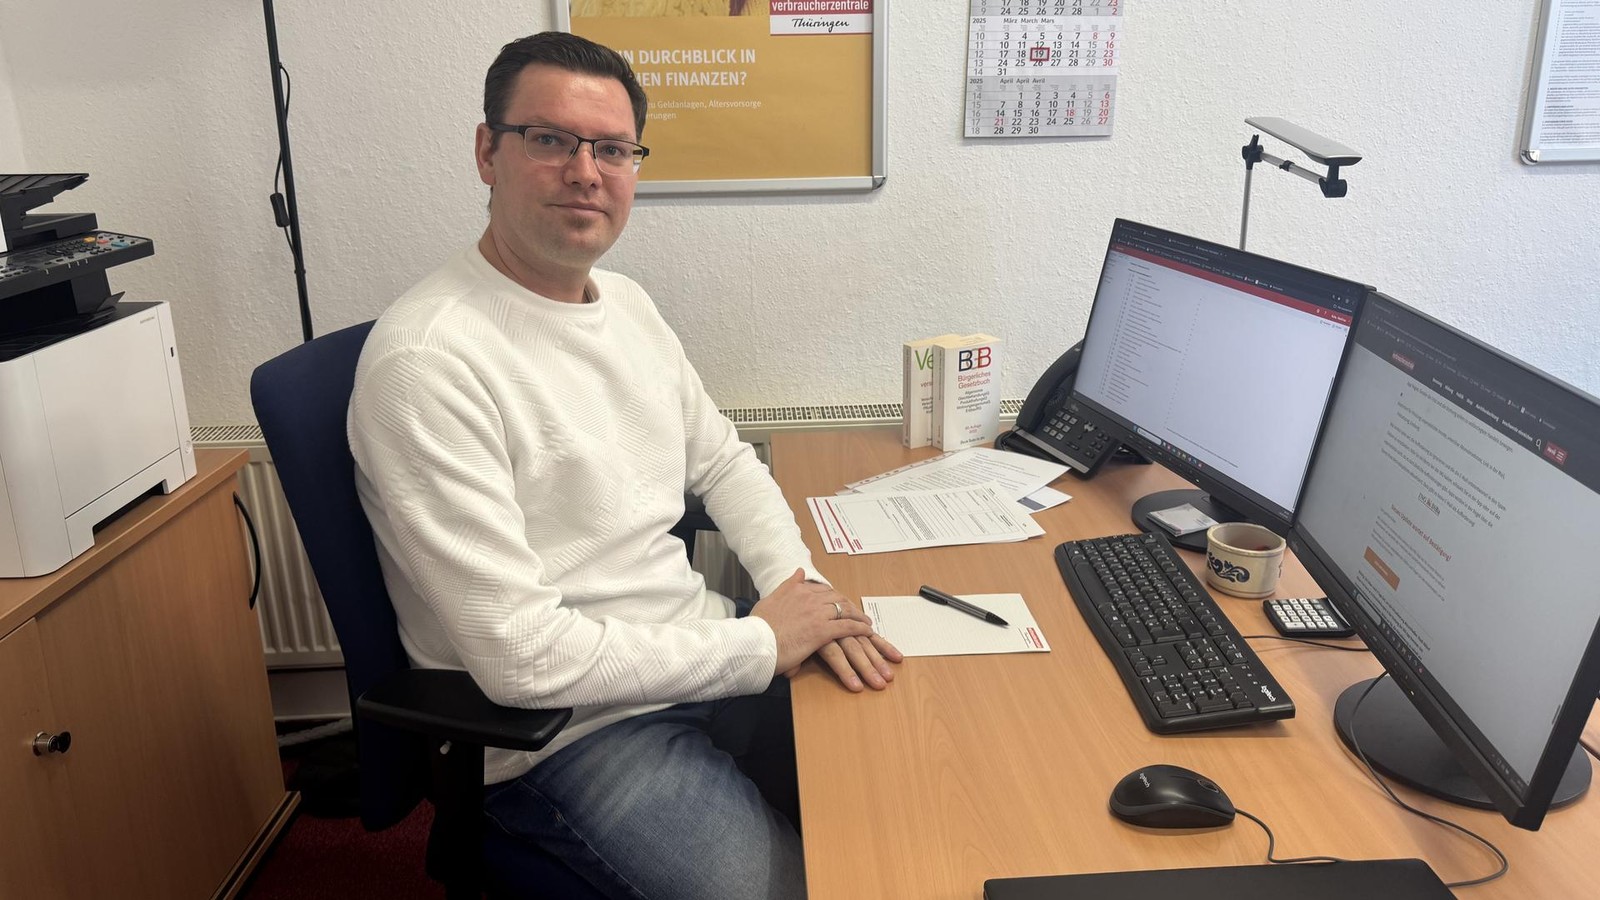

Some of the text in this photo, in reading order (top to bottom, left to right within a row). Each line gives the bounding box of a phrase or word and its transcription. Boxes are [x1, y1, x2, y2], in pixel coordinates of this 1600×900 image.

[772, 0, 869, 11] verbraucherzentrale
[1001, 7, 1010, 15] 24
[1018, 7, 1028, 15] 25
[1036, 7, 1046, 15] 26
[1095, 7, 1099, 16] 1
[1112, 7, 1117, 16] 2
[792, 17, 850, 32] Thüringen
[639, 49, 736, 64] DURCHBLICK
[741, 49, 756, 63] IN
[1086, 58, 1096, 66] 29
[1103, 58, 1113, 66] 30
[666, 72, 747, 86] FINANZEN?
[658, 101, 707, 110] Geldanlagen,
[709, 100, 762, 109] Altersvorsorge
[1083, 100, 1092, 108] 12
[1083, 108, 1092, 117] 19
[1081, 117, 1091, 125] 26
[958, 371, 991, 382] Bürgerliches
[958, 379, 990, 389] Gesetzbuch
